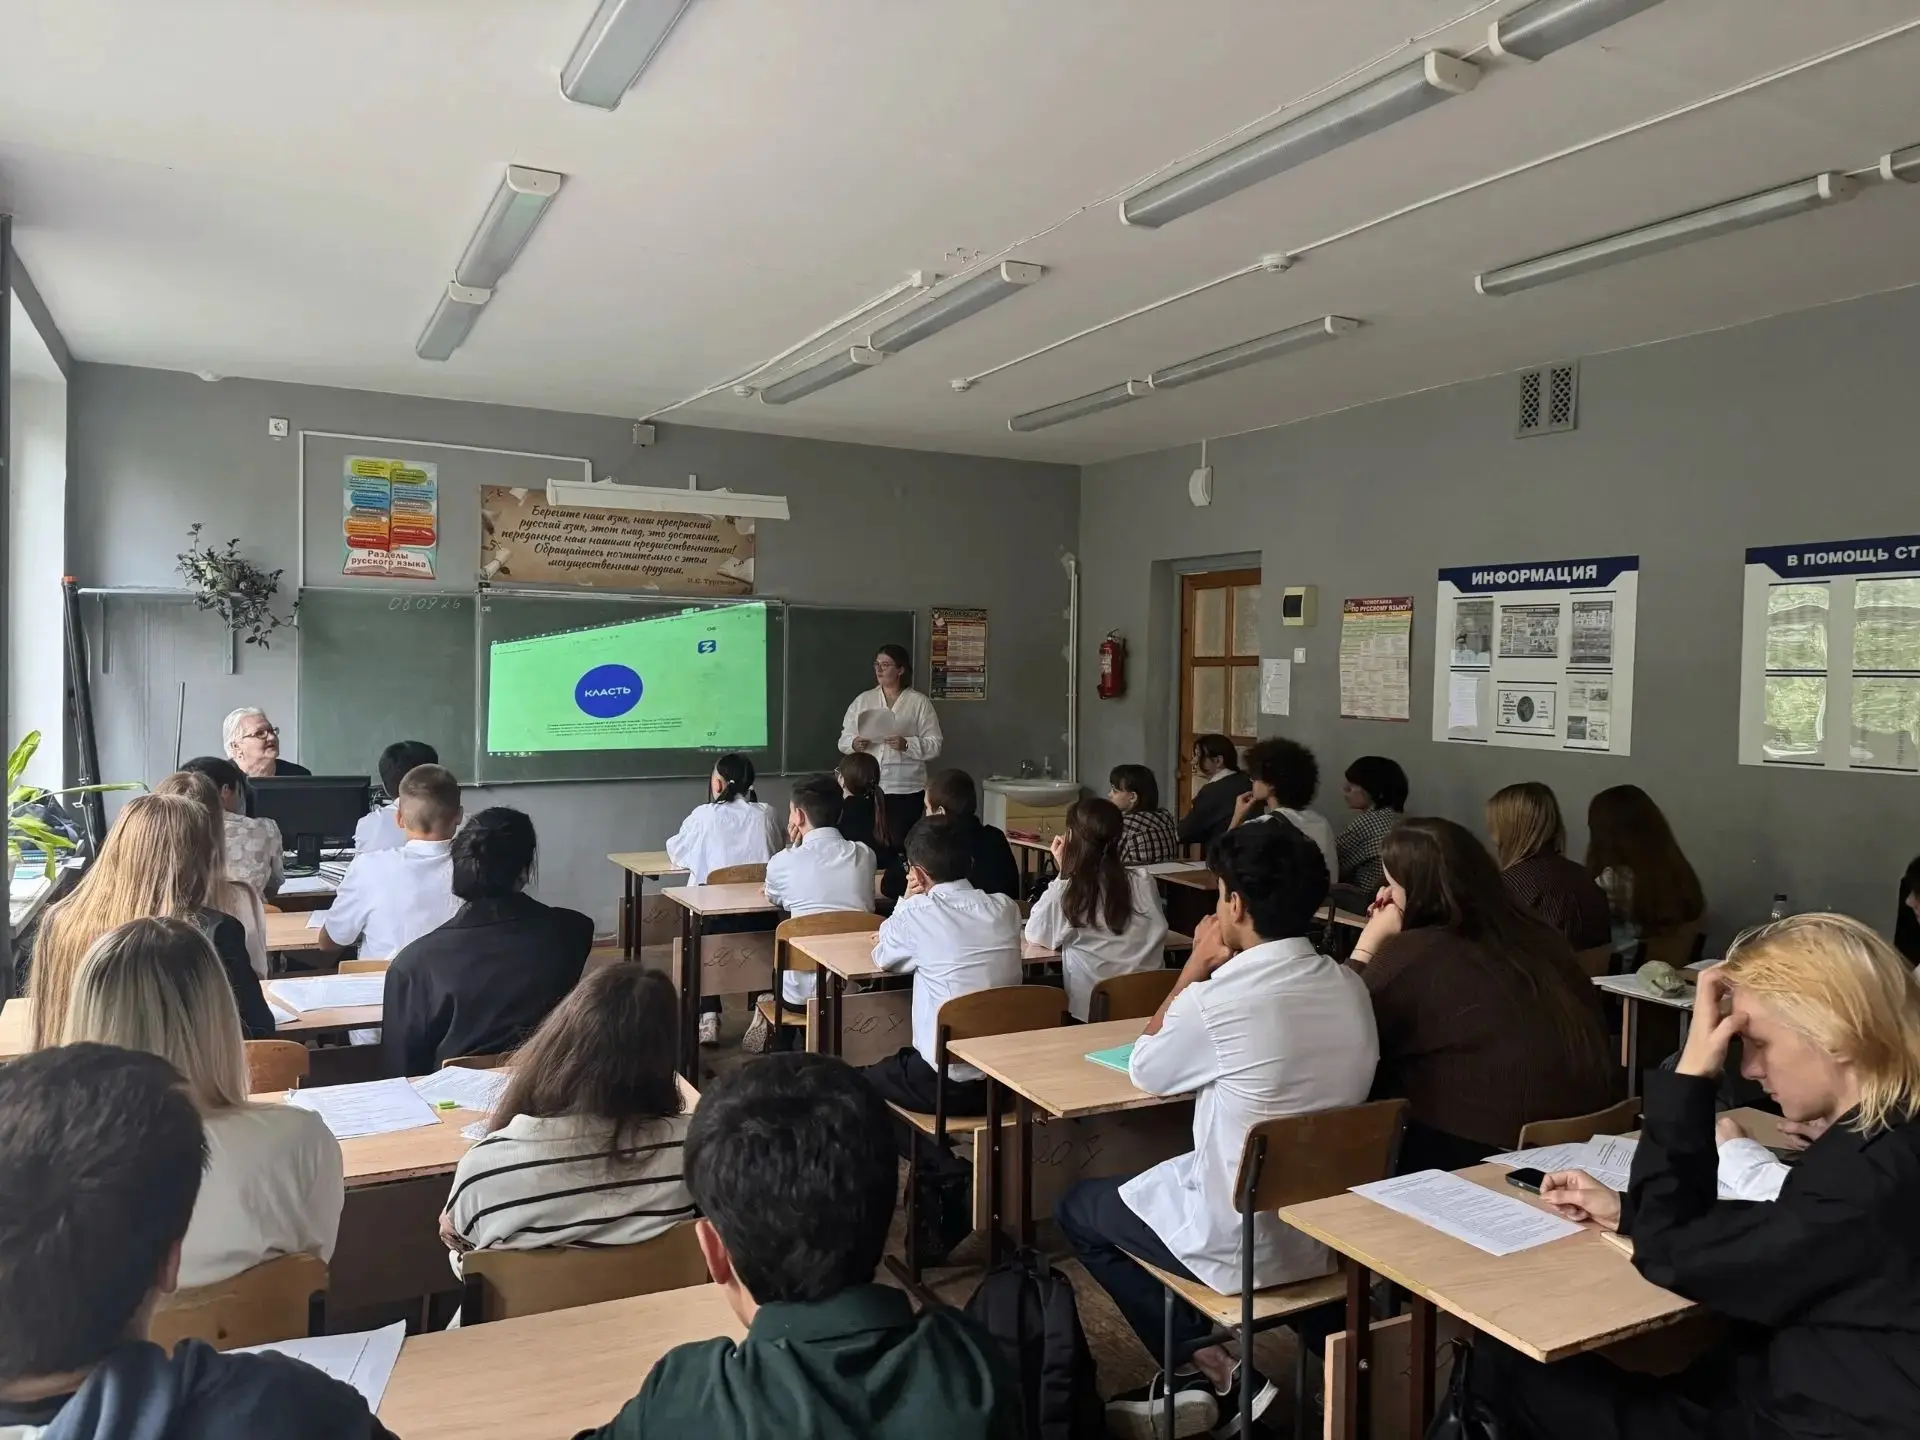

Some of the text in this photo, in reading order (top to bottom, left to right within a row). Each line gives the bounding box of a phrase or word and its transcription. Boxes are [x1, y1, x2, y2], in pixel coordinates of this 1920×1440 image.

[531, 505, 581, 520] Берегите
[583, 511, 605, 520] наш
[633, 516, 655, 525] наш
[519, 519, 561, 531] русский
[590, 526, 619, 534] этот
[621, 527, 645, 540] клад,
[647, 529, 666, 538] это
[501, 530, 737, 555] переданное нам нашими предшественниками!
[351, 557, 426, 568] русского языка
[367, 550, 409, 560] Разделы
[534, 542, 604, 557] Обращайтесь
[606, 551, 672, 562] почтительно
[681, 556, 708, 564] этим
[1787, 554, 1799, 567] В
[1803, 548, 1889, 566] ПОМОЩЬ
[1471, 565, 1598, 585] ИНФОРМАЦИЯ
[584, 686, 631, 697] КЛАСТЬ
